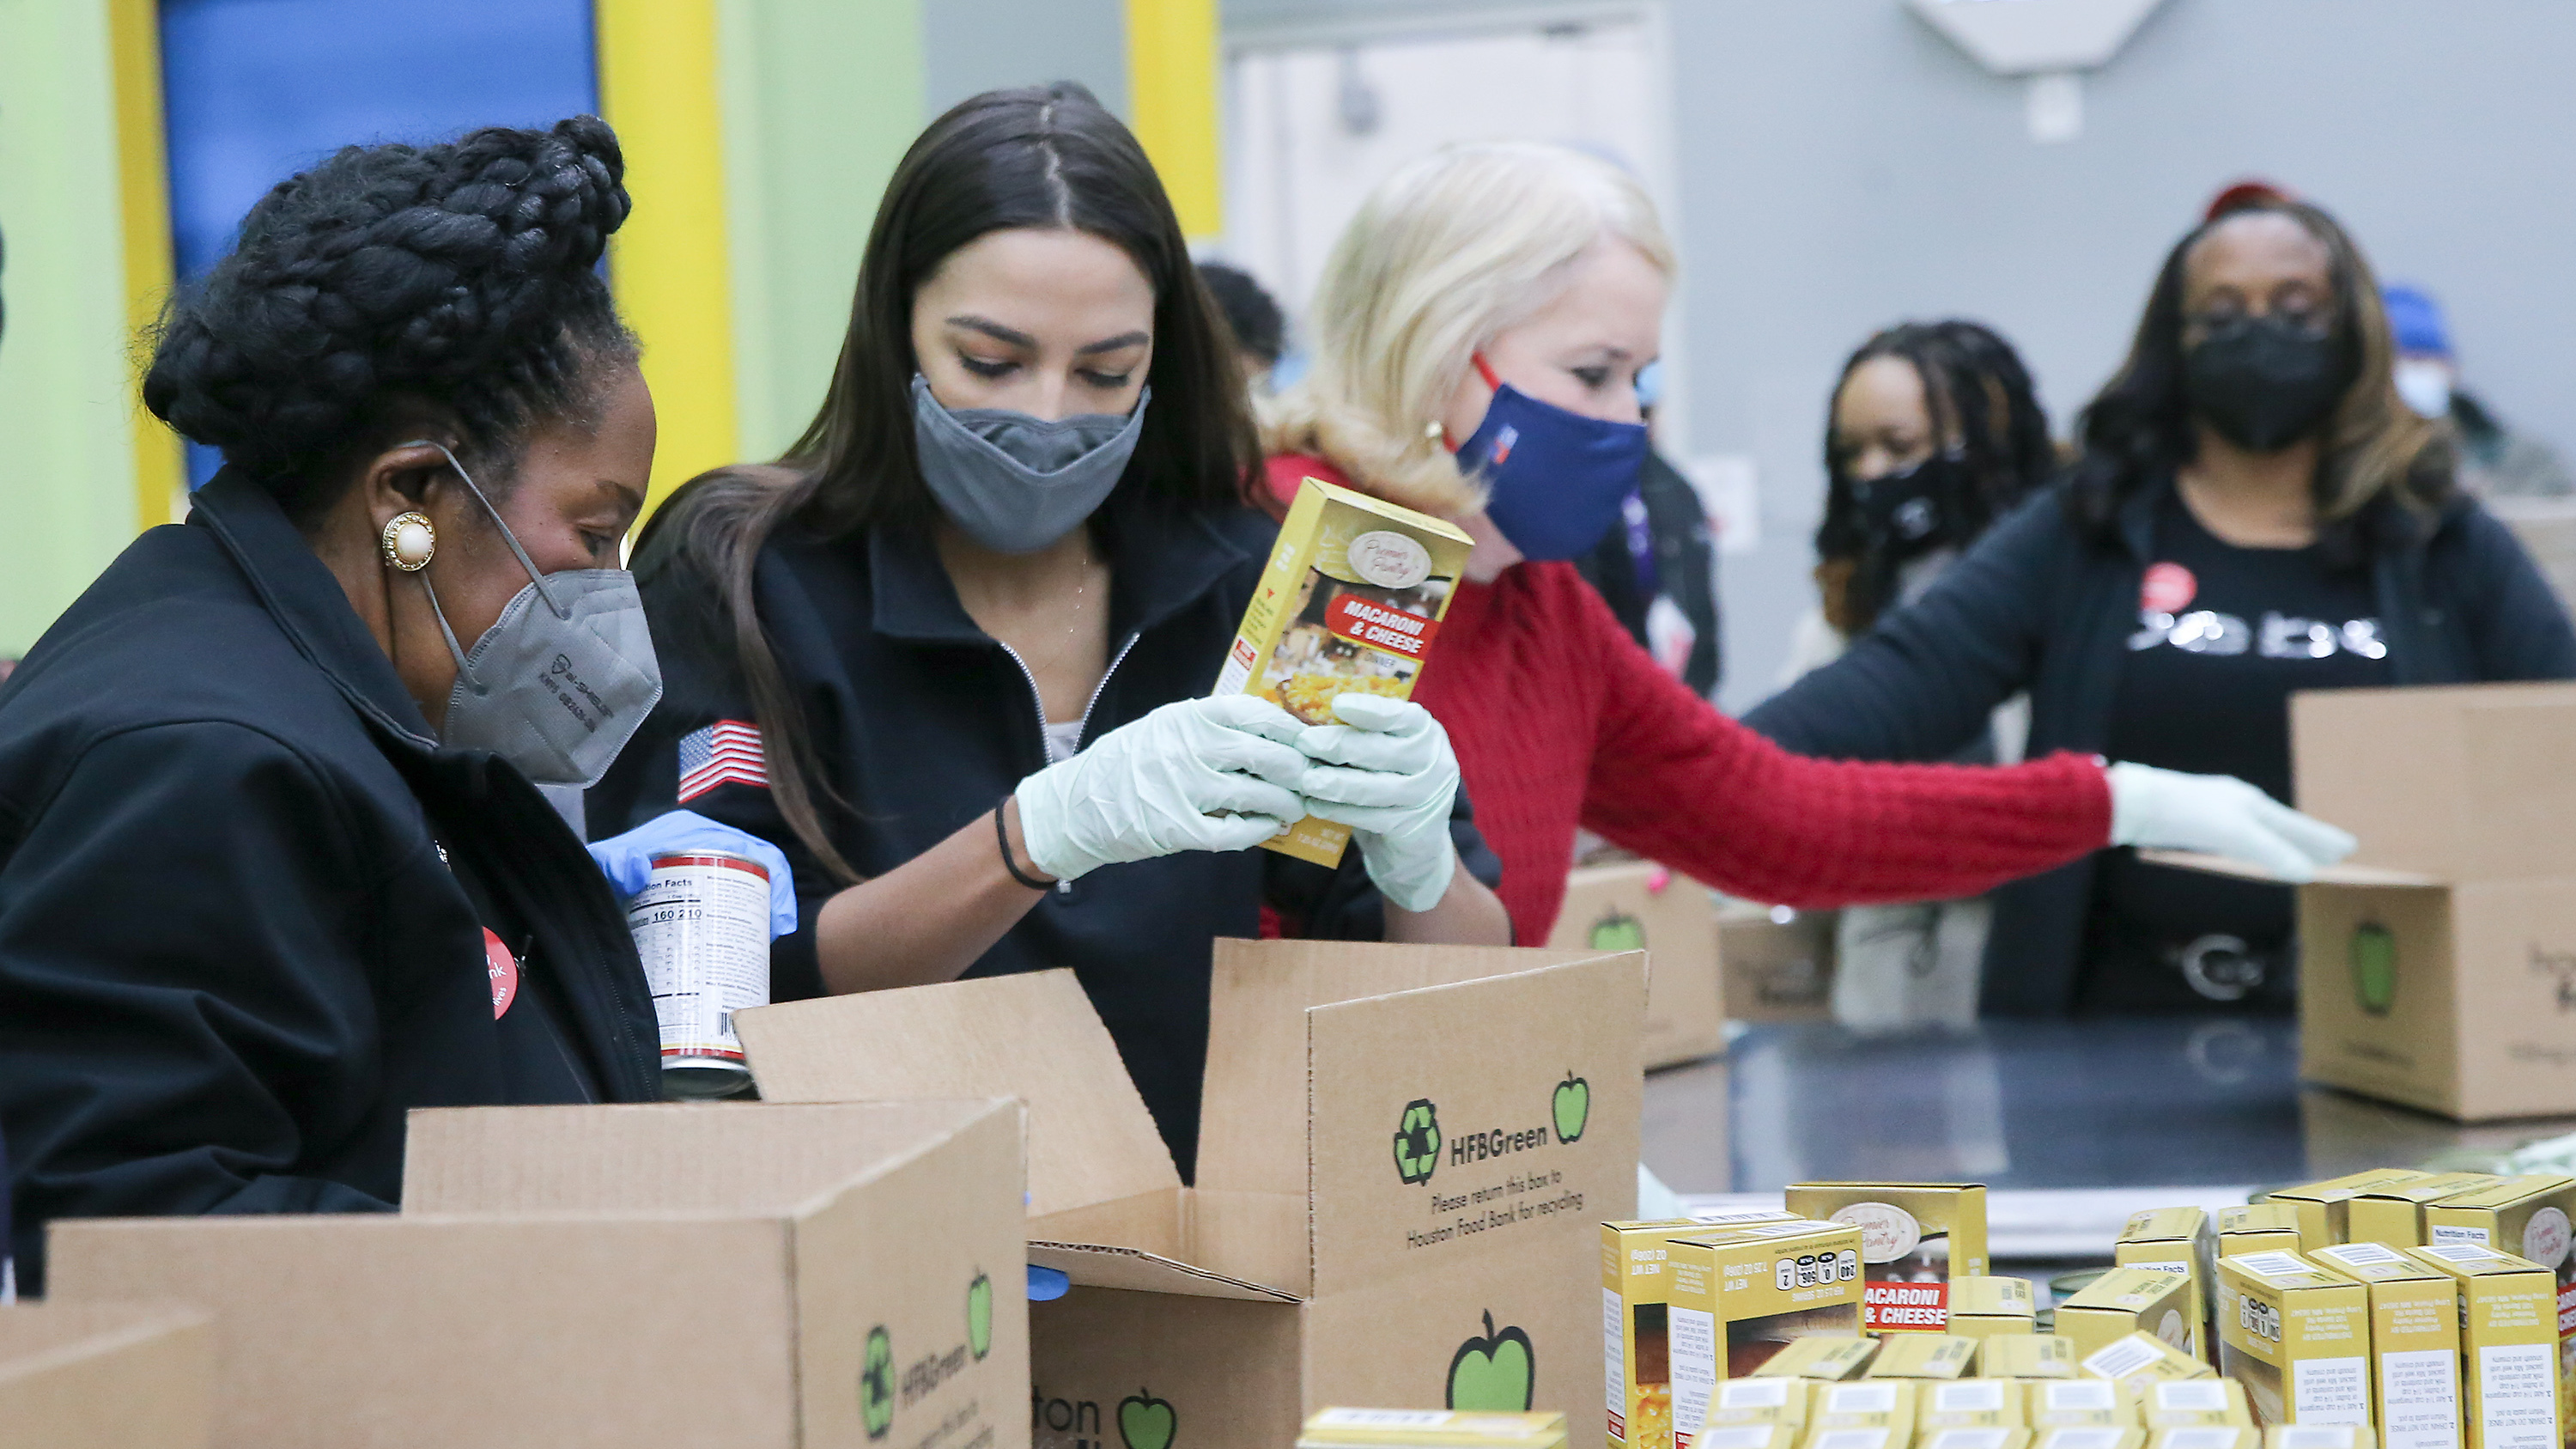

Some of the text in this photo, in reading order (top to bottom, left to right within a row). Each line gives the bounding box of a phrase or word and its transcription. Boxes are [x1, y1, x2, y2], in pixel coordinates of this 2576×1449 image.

[1343, 600, 1425, 636] MACARONI
[1349, 620, 1425, 654] & CHEESE
[665, 879, 692, 888] Facts
[654, 910, 675, 921] 160
[677, 909, 702, 919] 210
[489, 962, 507, 979] nk
[1451, 1126, 1547, 1167] HFBGreen
[1431, 1168, 1562, 1215] Please return this box to
[1407, 1189, 1583, 1250] Houston Food Bank for recycling
[2435, 1229, 2487, 1240] Nutrition Facts
[1840, 1265, 1856, 1278] 240
[1864, 1288, 1941, 1306] ACARONI
[1865, 1306, 1948, 1325] & CHEESE
[1031, 1385, 1101, 1435] ton
